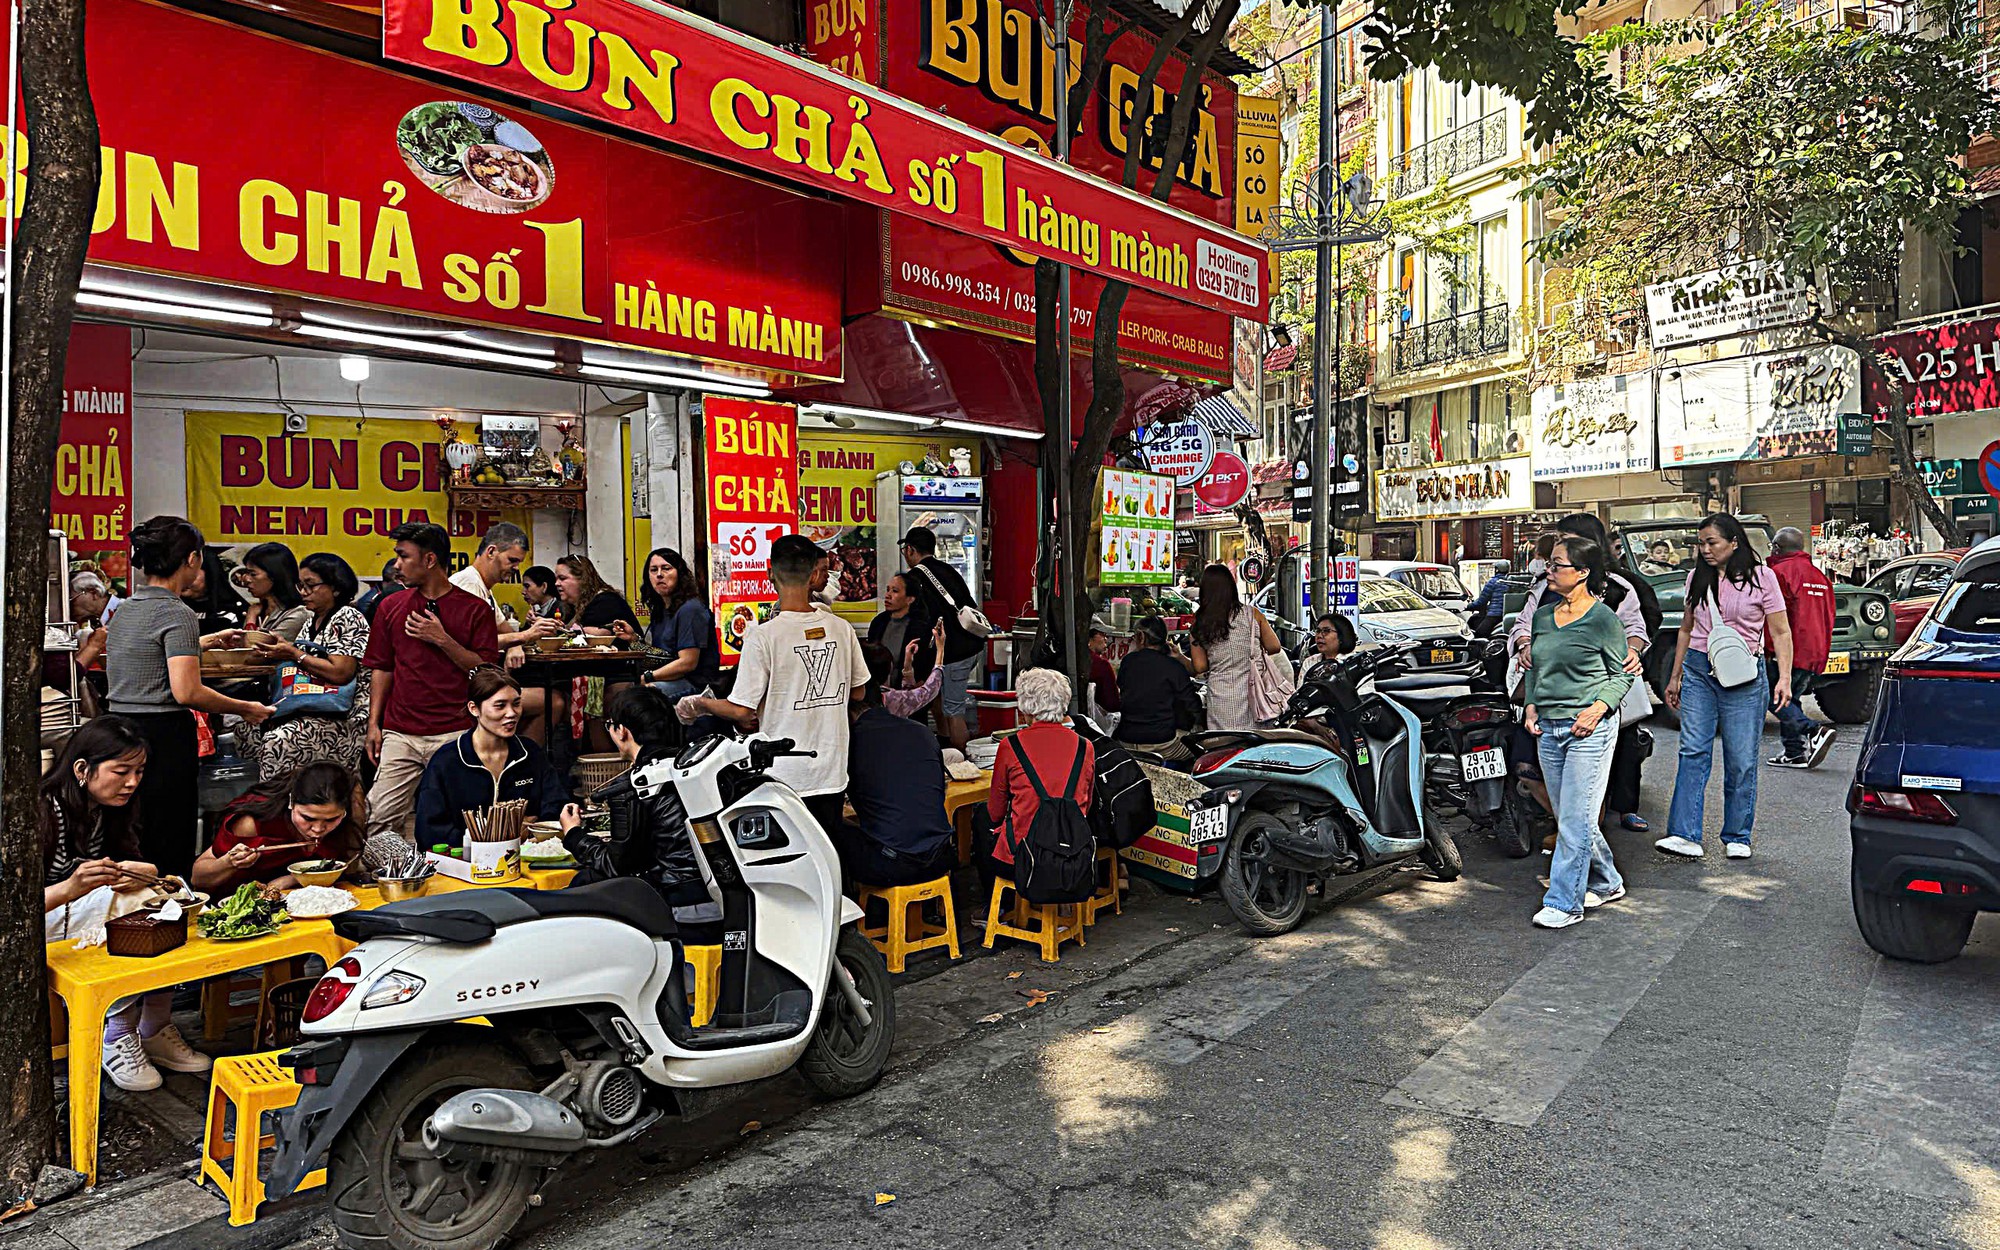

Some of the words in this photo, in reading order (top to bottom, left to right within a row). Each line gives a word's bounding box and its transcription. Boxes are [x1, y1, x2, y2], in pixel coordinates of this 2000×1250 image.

[1245, 144, 1265, 165] SÔ
[710, 96, 894, 195] CHẢ
[966, 148, 1006, 232] 1
[1018, 187, 1100, 267] hàng
[1111, 226, 1189, 290] mành
[1244, 174, 1266, 195] CÔ
[1246, 207, 1263, 224] LA
[239, 180, 423, 290] CHẢ
[523, 218, 603, 324] 1
[614, 279, 717, 344] HÀNG
[727, 306, 824, 362] MÀNH
[1208, 246, 1249, 278] Hotline
[901, 261, 1001, 304] 0986.998.354
[1198, 267, 1222, 293] 0329
[1224, 275, 1240, 299] 578
[1240, 282, 1256, 304] 797
[1172, 333, 1197, 353] CRAB
[1197, 340, 1224, 360] RALLS
[1665, 333, 1674, 343] 28
[1896, 347, 1959, 384] A25
[73, 387, 125, 415] MÀNH
[1848, 418, 1864, 428] BIDV
[714, 412, 790, 459] BÚN
[1151, 439, 1172, 453] 4G
[1181, 439, 1202, 451] 5G
[1846, 432, 1872, 441] AUTOBANK
[817, 448, 875, 470] MÀNH
[1150, 453, 1203, 465] EXCHANGE
[1852, 445, 1866, 453] 24/7
[56, 427, 125, 497] CHẢ
[1159, 465, 1195, 476] MONEY
[1216, 472, 1240, 481] PKT
[714, 467, 793, 514] CHẢ
[1967, 499, 1988, 507] ATM
[93, 504, 126, 541] BỂ
[220, 506, 328, 536] NEM
[729, 526, 757, 556] SỐ
[744, 558, 765, 570] MÀNH
[1345, 561, 1356, 579] 5G
[1466, 750, 1497, 767] 29-D2
[1156, 800, 1171, 812] NC
[1195, 808, 1222, 826] 29-C1
[1155, 828, 1171, 840] NC
[1190, 822, 1225, 843] 985.43
[1129, 848, 1145, 861] NC
[1154, 857, 1171, 869] NC
[1180, 864, 1197, 877] NC
[456, 979, 542, 1002] SCOOPY
